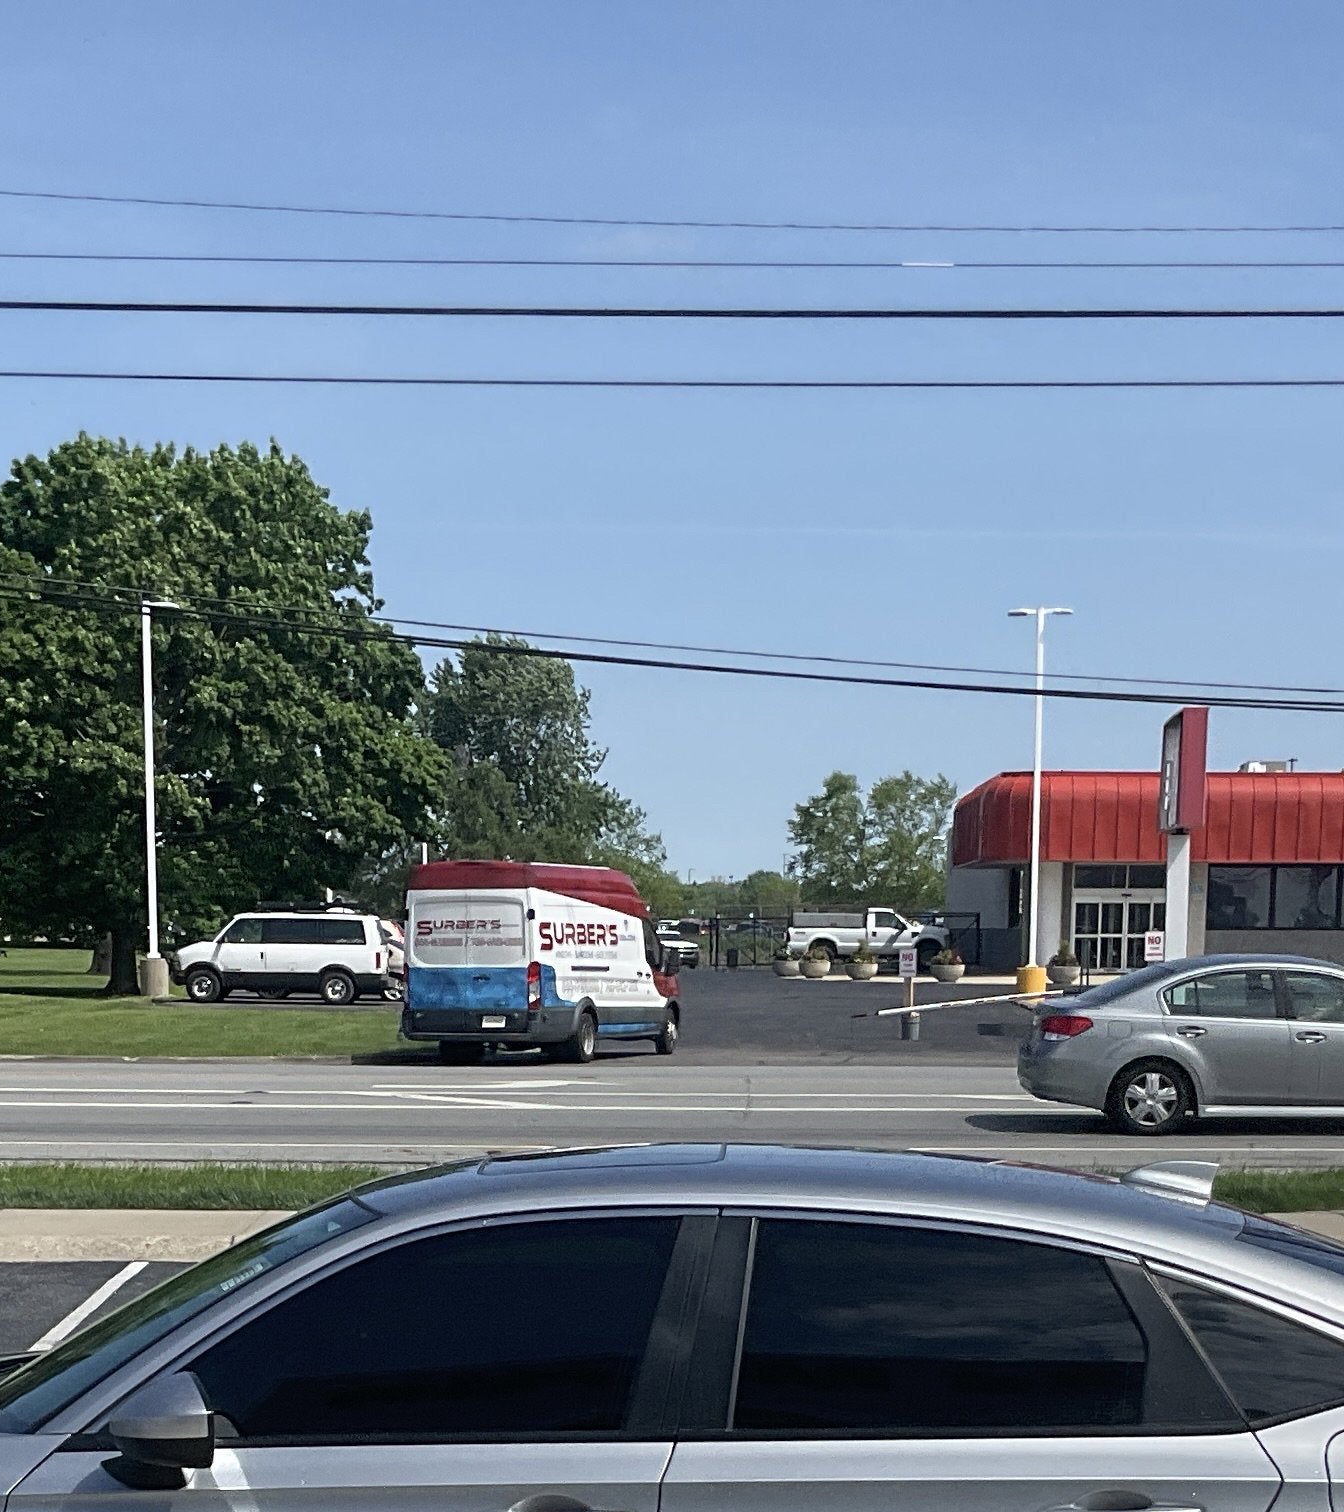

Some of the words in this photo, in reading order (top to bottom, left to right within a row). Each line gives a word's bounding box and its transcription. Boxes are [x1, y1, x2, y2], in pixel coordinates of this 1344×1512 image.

[416, 919, 502, 936] SURBER'S
[539, 922, 618, 950] SURBER'S
[1147, 936, 1161, 945] NO
